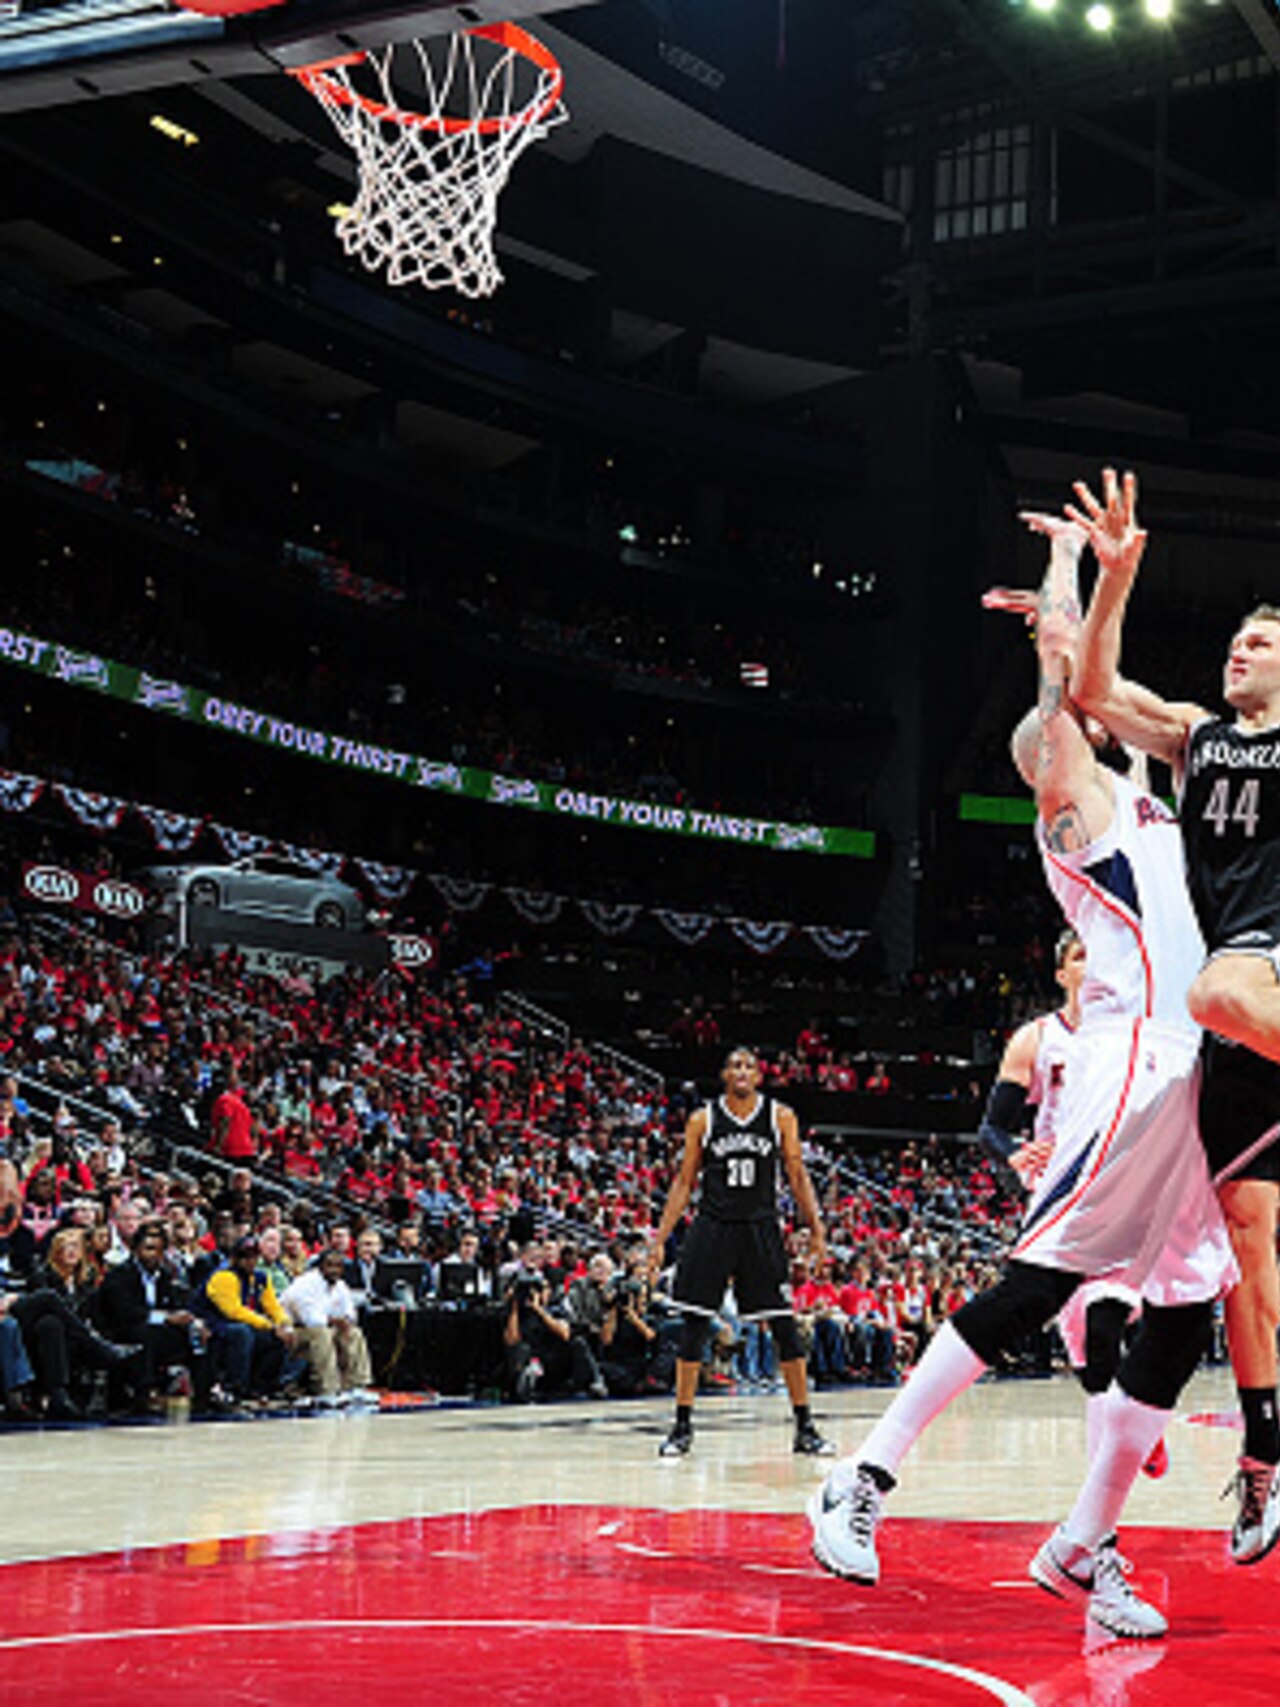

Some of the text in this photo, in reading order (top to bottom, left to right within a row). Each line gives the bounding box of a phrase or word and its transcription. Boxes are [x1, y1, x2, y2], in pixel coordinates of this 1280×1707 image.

[204, 698, 267, 734] OBEY
[266, 717, 326, 757] YOUR
[330, 735, 410, 779] THIRST
[555, 788, 618, 820] OBEY
[618, 798, 684, 831] YOUR
[690, 812, 771, 842] THIRST
[1201, 777, 1261, 838] 44
[32, 871, 75, 899] KIA
